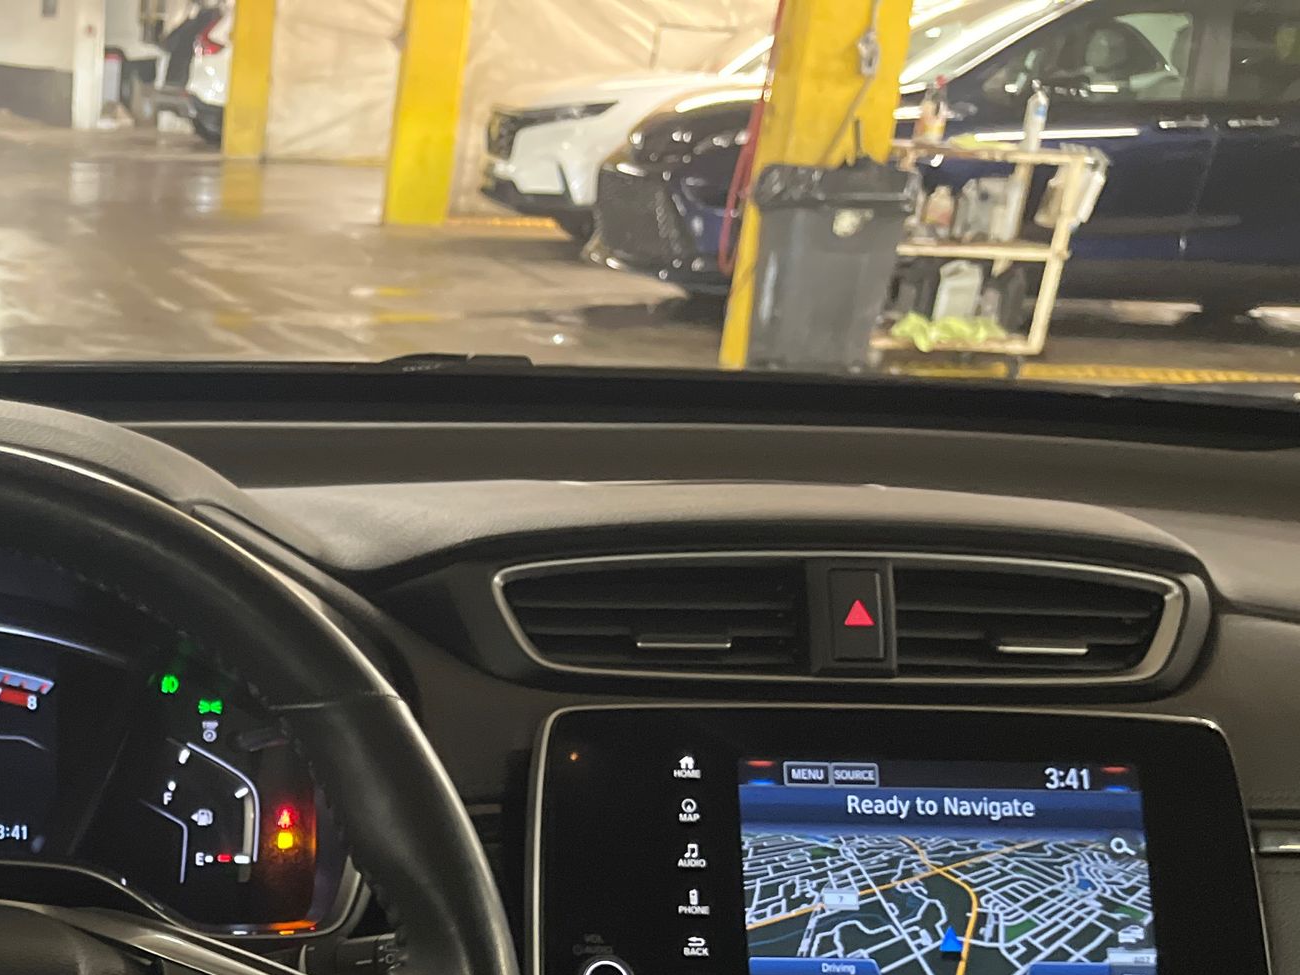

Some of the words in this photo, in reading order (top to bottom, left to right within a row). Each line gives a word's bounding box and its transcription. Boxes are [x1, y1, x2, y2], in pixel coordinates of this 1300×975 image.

[27, 695, 38, 710] 8
[673, 769, 701, 779] HOME
[791, 768, 825, 780] MENU
[834, 769, 876, 780] SOURCE
[1044, 767, 1090, 790] 3:41
[163, 791, 172, 805] F
[847, 795, 910, 819] Ready
[915, 797, 938, 815] to
[943, 797, 1035, 820] Navigate
[678, 813, 700, 823] MAP
[195, 852, 205, 866] E
[678, 858, 707, 868] AUDIO
[678, 905, 710, 915] PHONE
[683, 947, 709, 957] BACK
[821, 962, 856, 975] Driving
